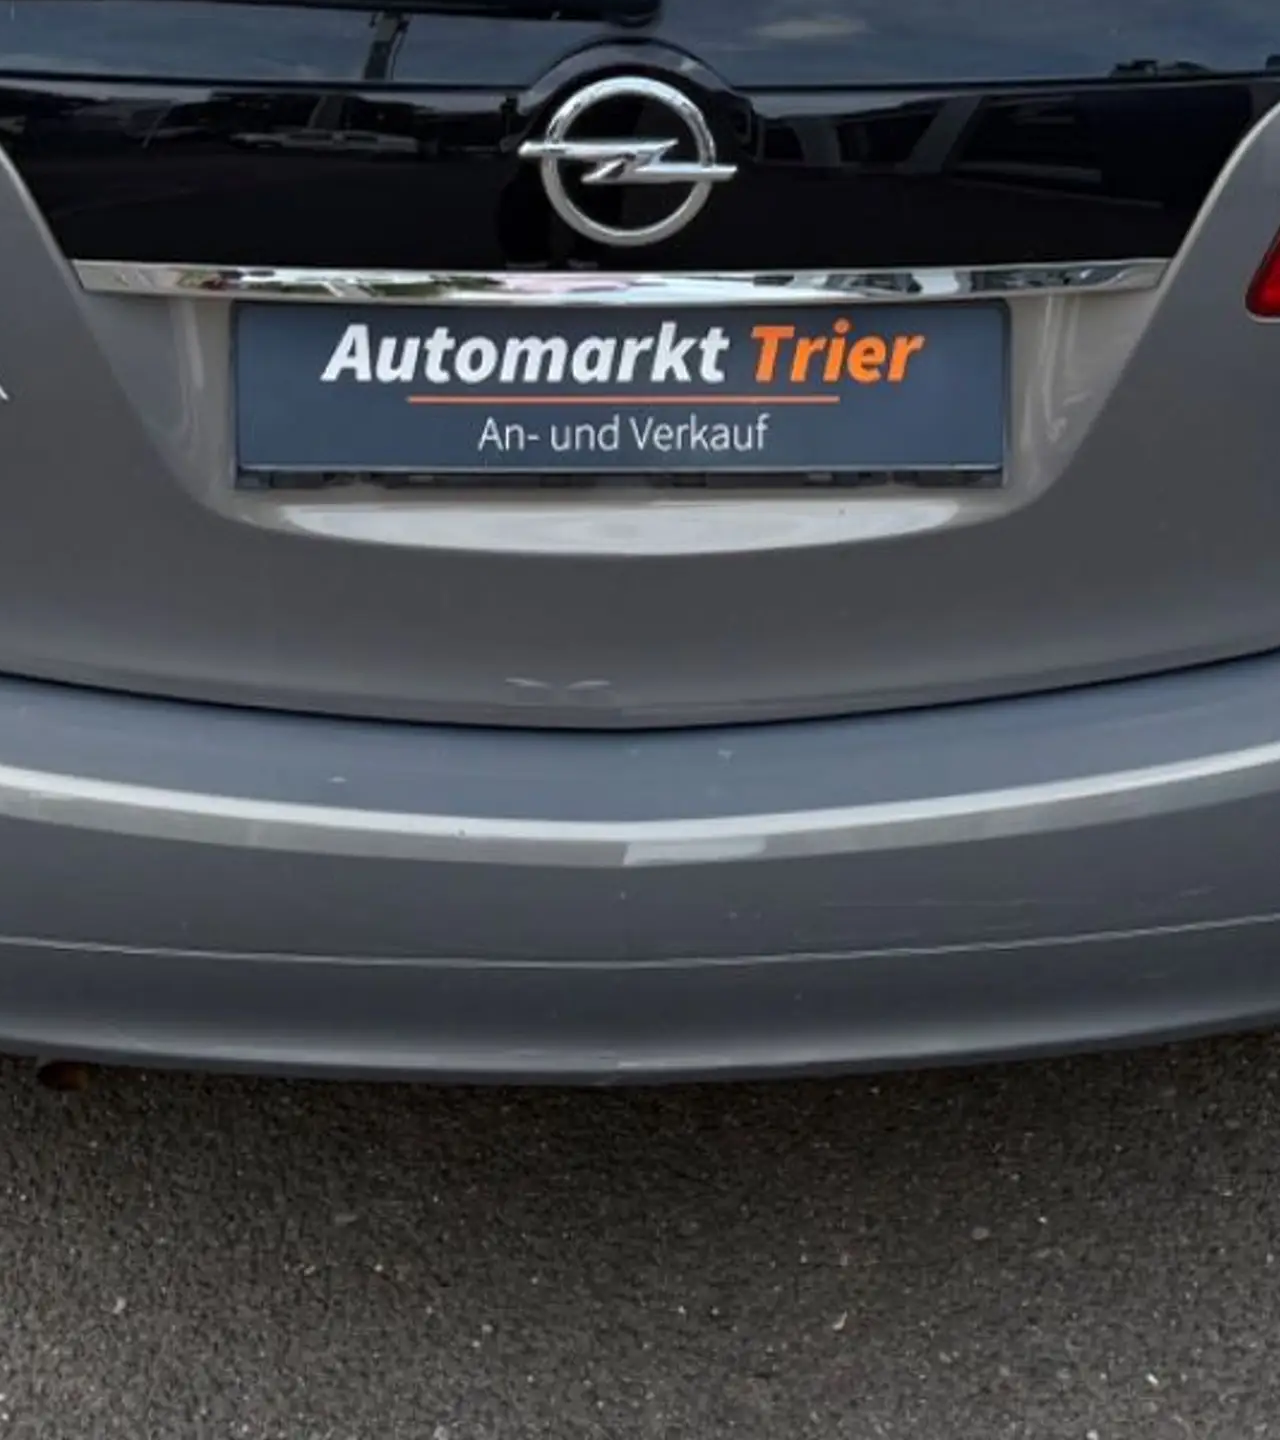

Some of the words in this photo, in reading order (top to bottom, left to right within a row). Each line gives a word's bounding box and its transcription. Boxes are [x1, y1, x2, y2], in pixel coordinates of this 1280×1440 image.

[320, 321, 730, 385] Automarkt
[751, 317, 926, 383] Trier
[478, 416, 539, 451] An-
[550, 414, 619, 452] und
[628, 412, 771, 452] Verkauf
